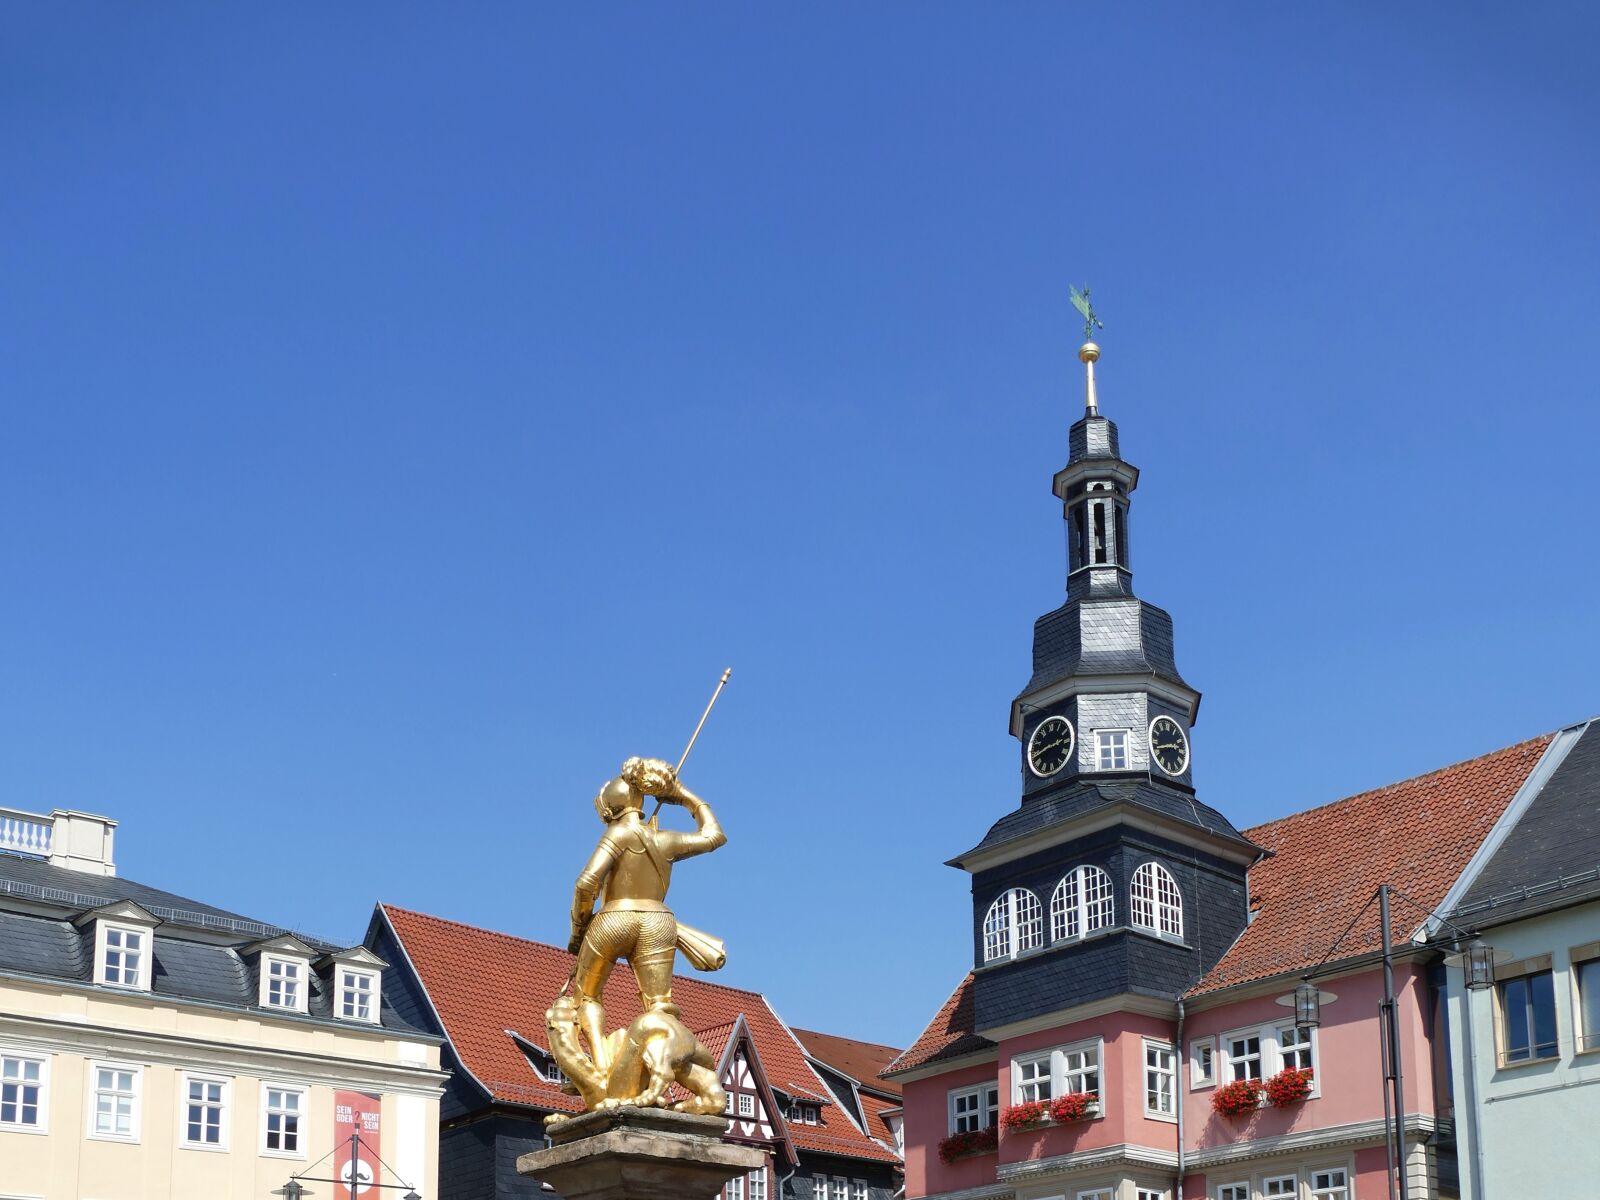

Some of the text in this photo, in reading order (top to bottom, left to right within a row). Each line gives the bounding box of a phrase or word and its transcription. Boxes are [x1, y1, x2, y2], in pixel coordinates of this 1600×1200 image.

[336, 1105, 352, 1114] SEIN
[336, 1114, 353, 1123] ODER
[361, 1112, 379, 1121] NICHT
[364, 1121, 379, 1130] SEIN
